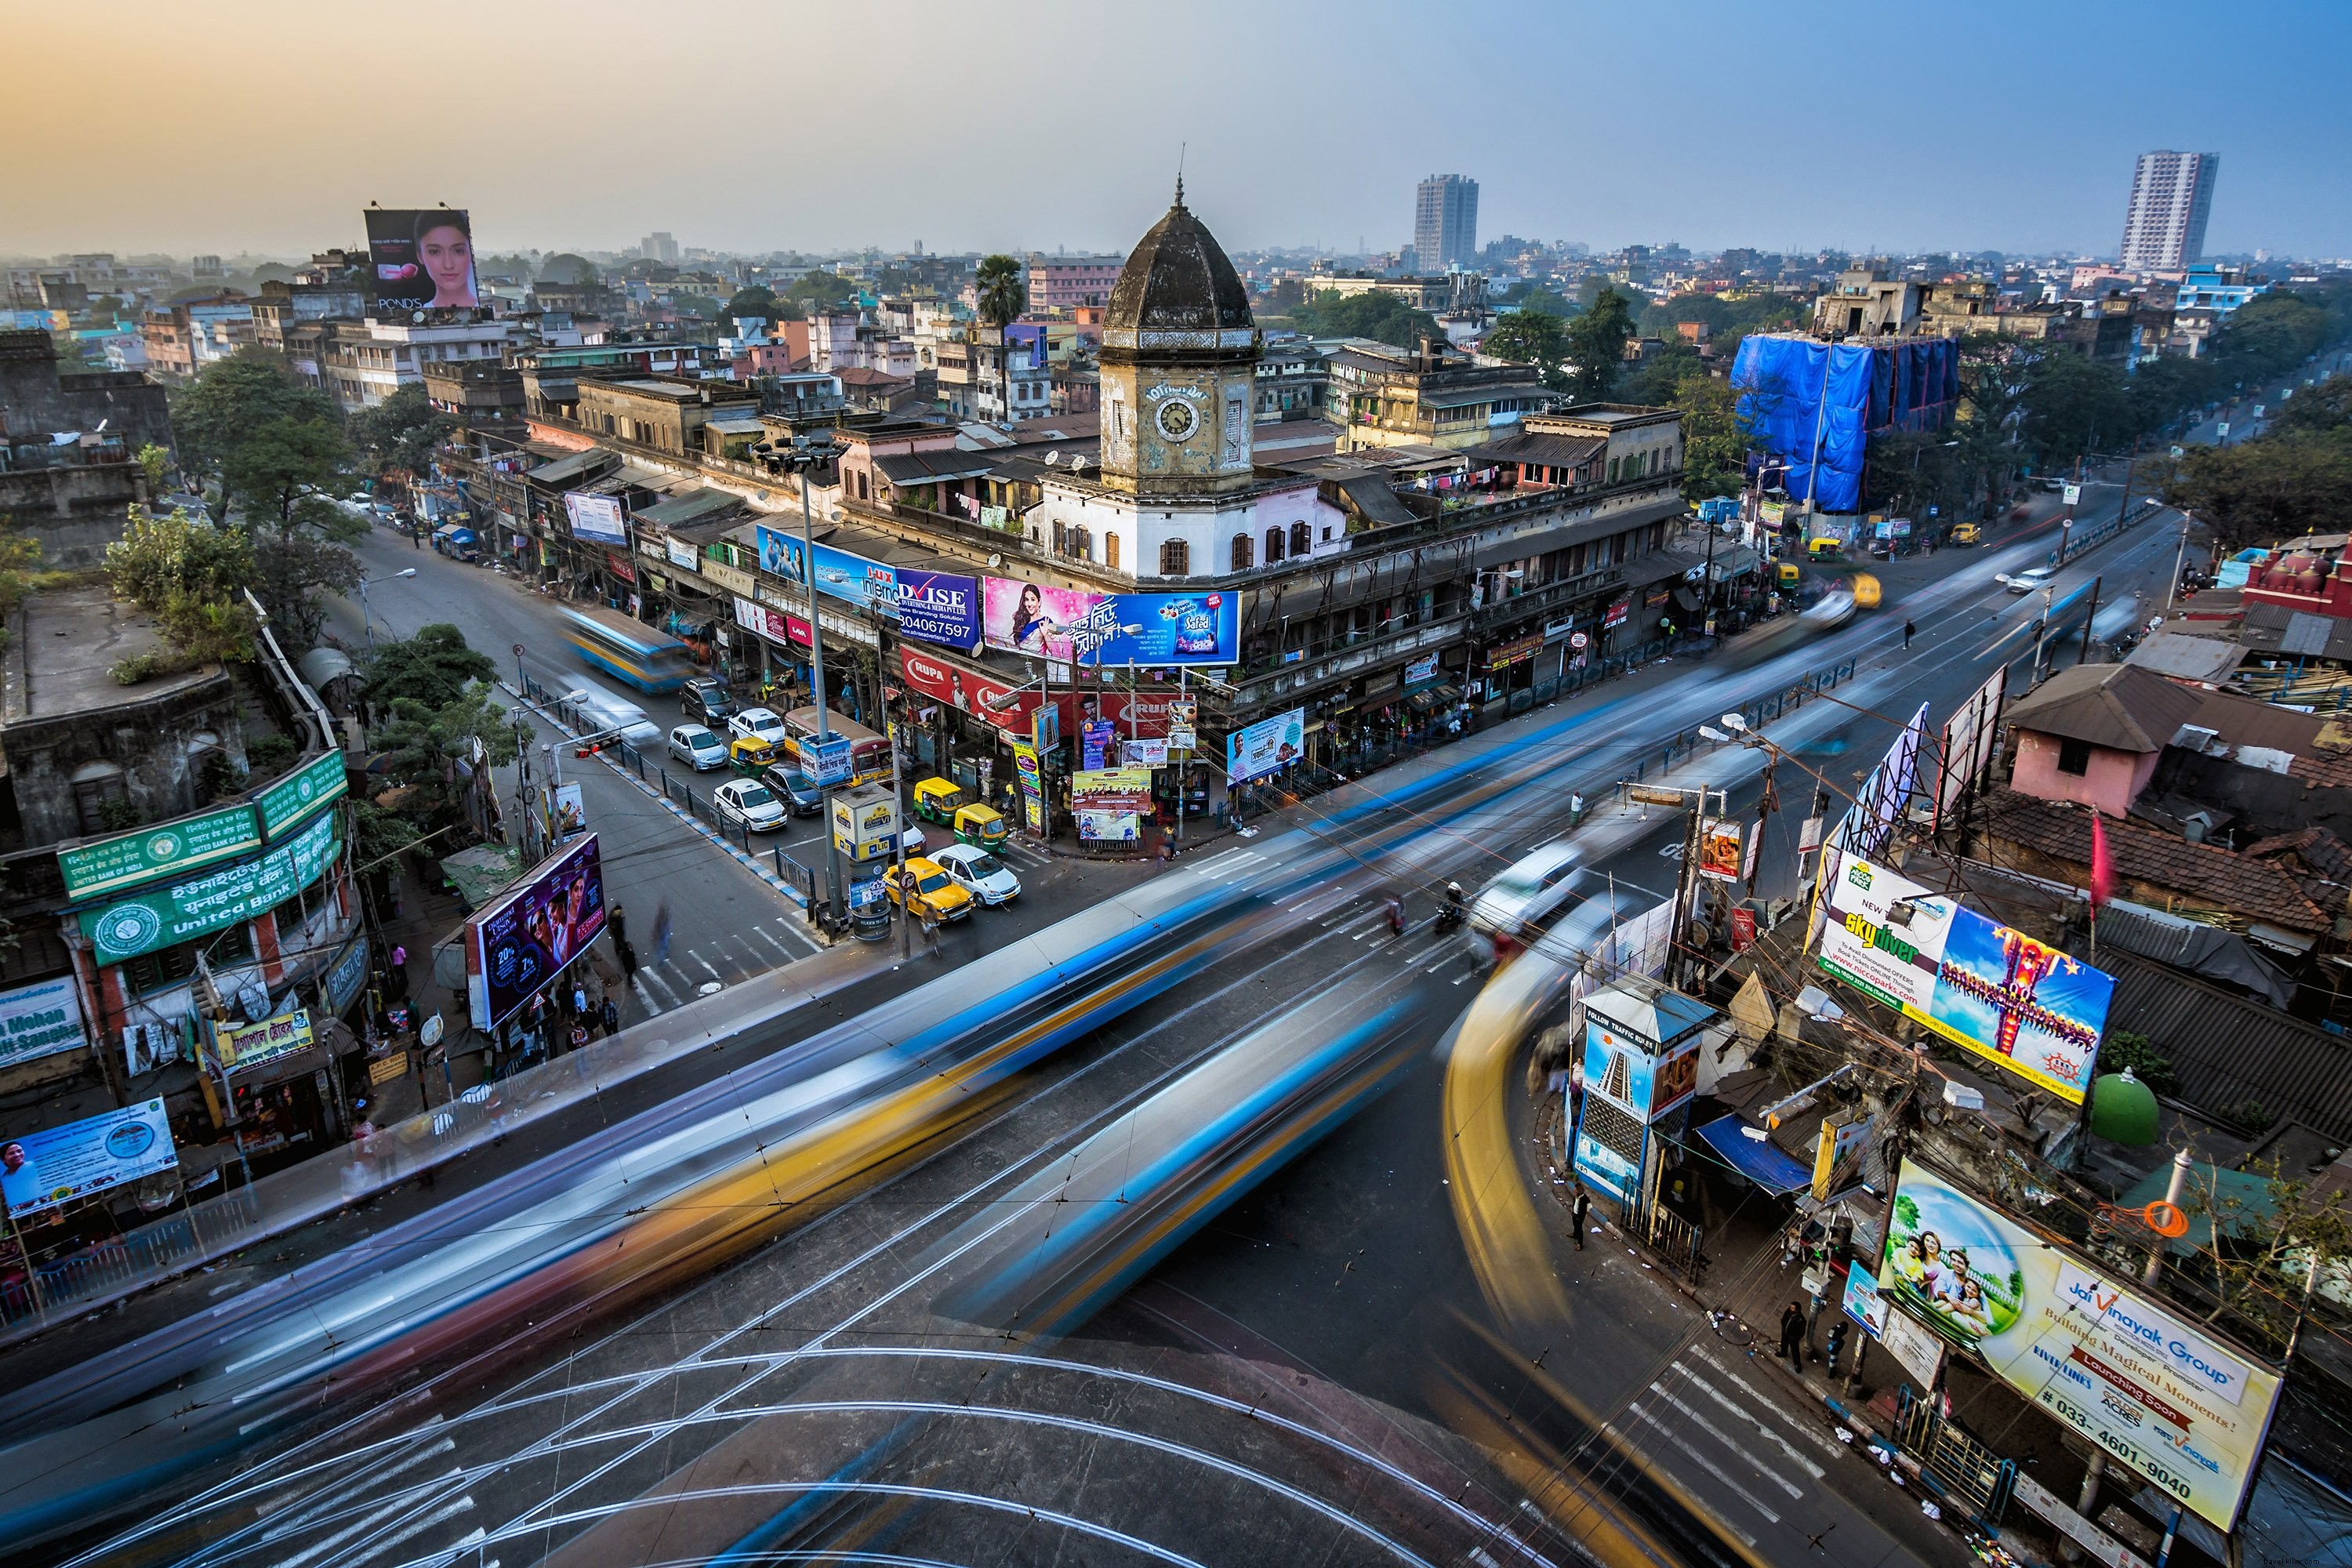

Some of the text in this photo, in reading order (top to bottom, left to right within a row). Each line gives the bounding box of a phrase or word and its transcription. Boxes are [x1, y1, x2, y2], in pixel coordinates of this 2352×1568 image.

[379, 298, 423, 309] POND'S
[898, 577, 966, 608] DVISE
[898, 598, 927, 610] DVERTISING
[932, 604, 946, 613] MEDIA
[912, 608, 938, 619] Branding
[939, 613, 964, 622] Solution
[1173, 601, 1191, 612] Power
[1178, 604, 1196, 615] Bullets
[792, 626, 807, 638] LAVA
[1185, 615, 1210, 630] Safed
[915, 661, 944, 681] RUPA
[986, 690, 1022, 711] RUA
[1135, 703, 1169, 713] RUP
[190, 832, 254, 855] UNITED BANK OF INDIA
[877, 841, 888, 851] LIC
[73, 862, 144, 887] UNITED BANK OF INDIA
[1849, 875, 1869, 891] PARK
[1851, 868, 1871, 884] NICCO
[173, 902, 245, 935] United
[249, 884, 291, 908] Bank
[313, 849, 333, 873] Inia
[1861, 898, 1883, 915] NEW
[498, 946, 515, 965] 20%
[1849, 946, 1861, 956] Avail
[1862, 953, 1891, 973] Discounted
[1892, 970, 1915, 986] OFFERS
[1824, 960, 1834, 970] Call
[1854, 978, 1865, 987] 2121
[1864, 984, 1873, 993] 316
[1873, 989, 1885, 999] (Toll
[1884, 994, 1897, 1006] Free)
[1832, 953, 1918, 1005] www.niccoparks.com
[1838, 947, 1915, 995] Book Tickets ONLINE Through
[7, 1008, 66, 1034] Mohan
[1588, 1010, 1610, 1026] FOLLOW
[1611, 1022, 1635, 1040] TRAFFIC
[1635, 1034, 1653, 1050] RULES
[1663, 1039, 1678, 1051] FOLLOW
[1908, 1007, 1926, 1022] Phone
[1939, 1024, 1948, 1033] 33
[1948, 1029, 1978, 1050] 66285564
[1984, 1048, 2002, 1061] 5509
[2002, 1056, 2034, 1077] (Between
[2038, 1076, 2051, 1087] am
[2050, 1082, 2064, 1094] and
[2069, 1282, 2228, 1385] Jai Vinayak Group
[2045, 1307, 2098, 1348] Building
[2099, 1341, 2161, 1387] Magical
[2079, 1312, 2205, 1393] Builder Developer Promoter
[2033, 1345, 2092, 1390] RIVER LINKS
[2084, 1355, 2143, 1401] Launching
[2145, 1395, 2177, 1421] Soon
[2042, 1390, 2053, 1403] #
[2056, 1400, 2094, 1431] 033-
[2100, 1398, 2141, 1428] ACRES
[2103, 1390, 2144, 1421] GOLDEN
[2174, 1434, 2220, 1474] Vinayak
